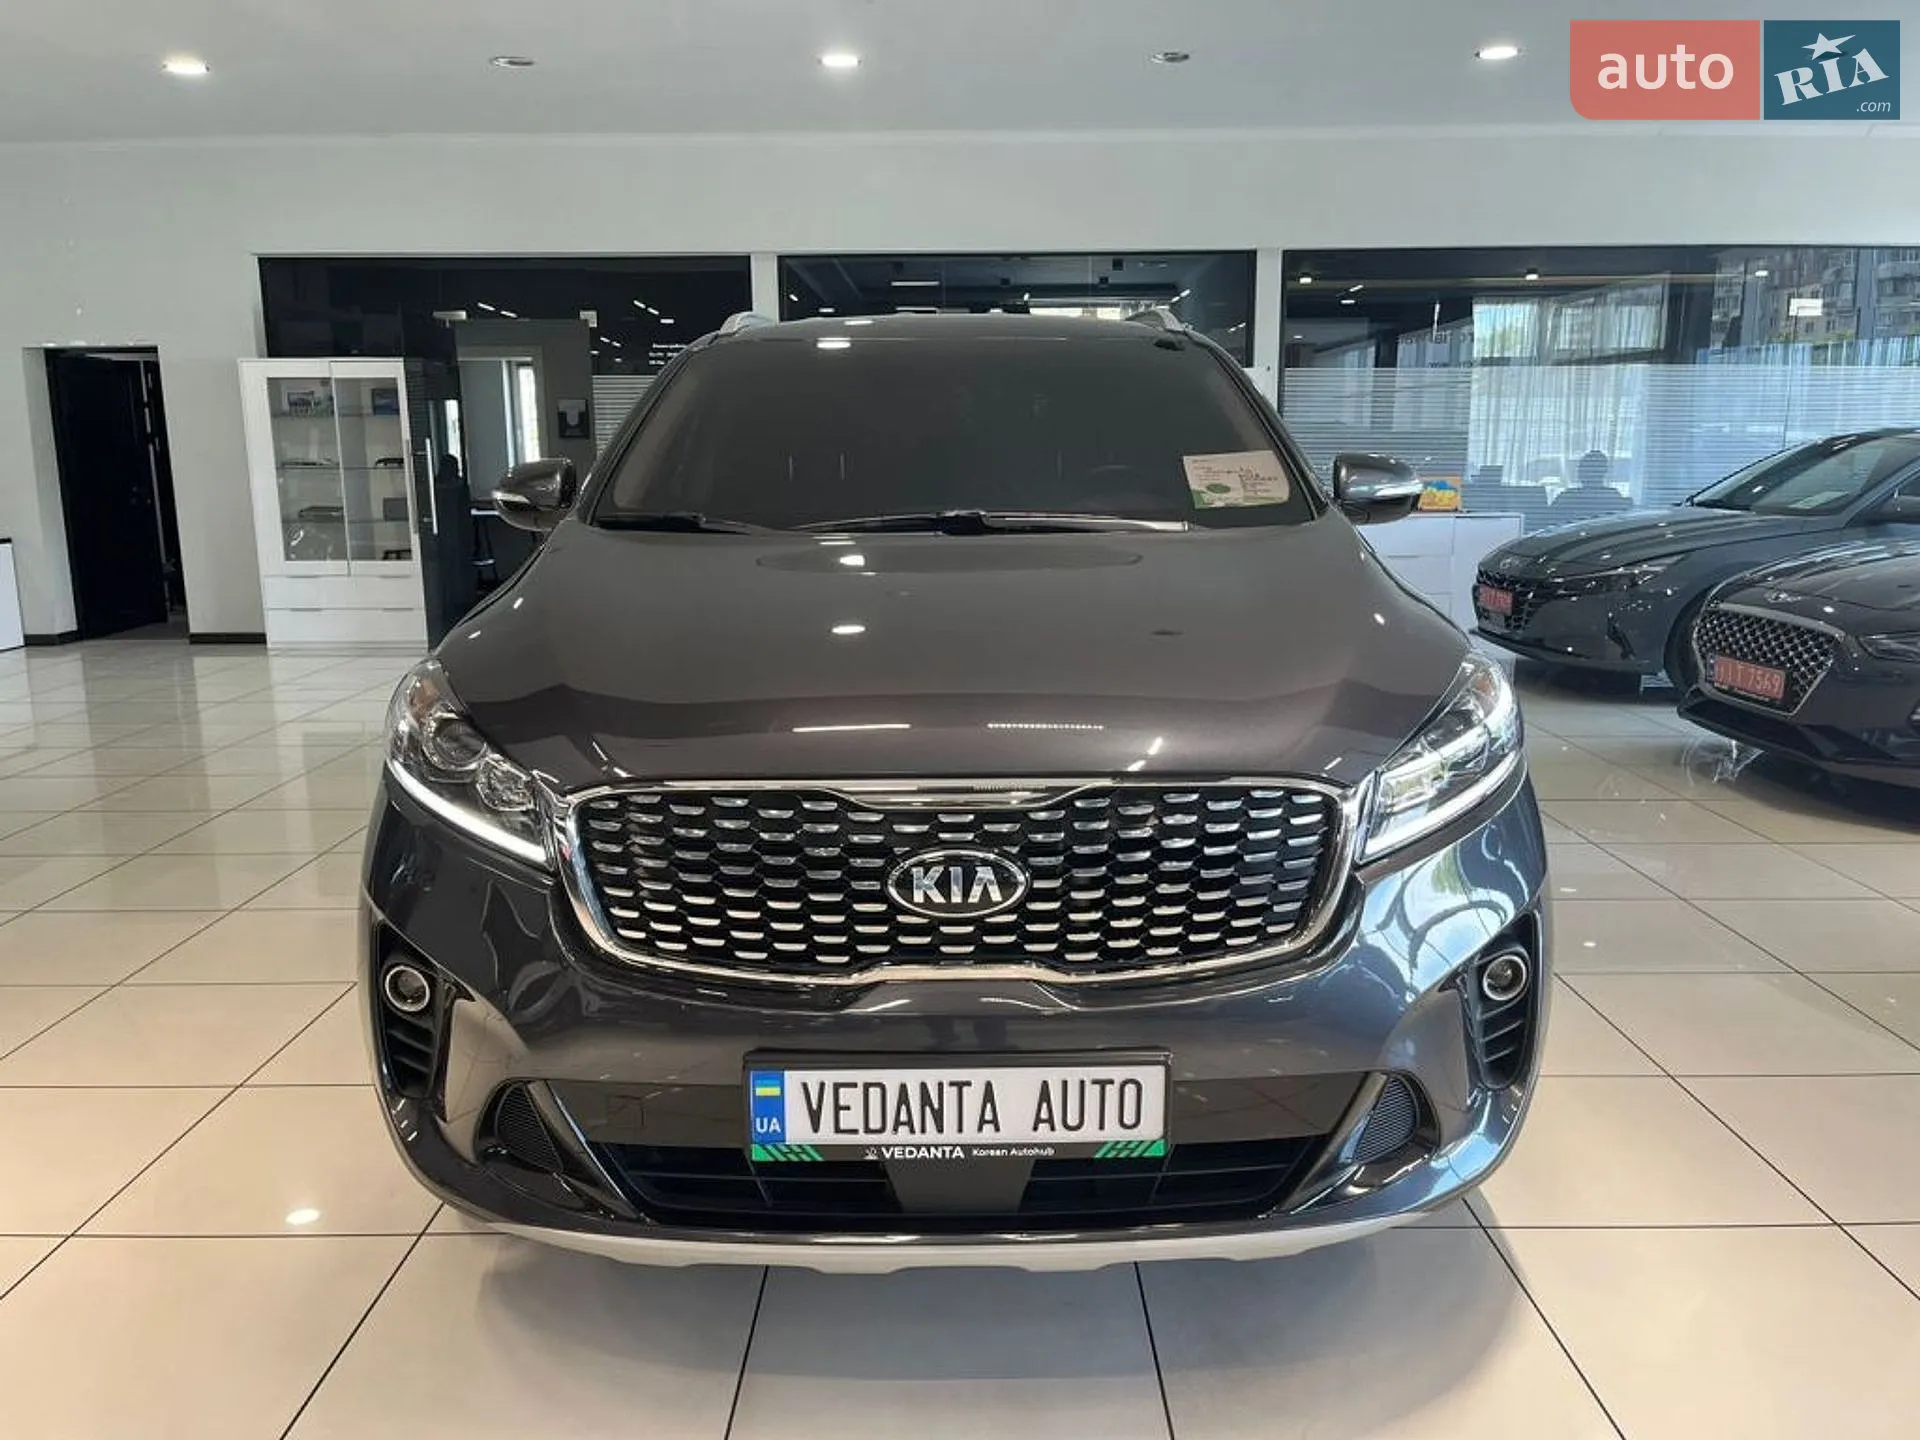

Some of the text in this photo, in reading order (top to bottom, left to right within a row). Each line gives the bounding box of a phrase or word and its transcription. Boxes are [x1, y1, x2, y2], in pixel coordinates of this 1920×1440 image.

[911, 865, 1003, 904] KIA
[802, 1078, 1143, 1135] VEDANTA AUTO
[755, 1117, 781, 1134] UA
[881, 1145, 1056, 1160] VEDANTA Korean Autohub
